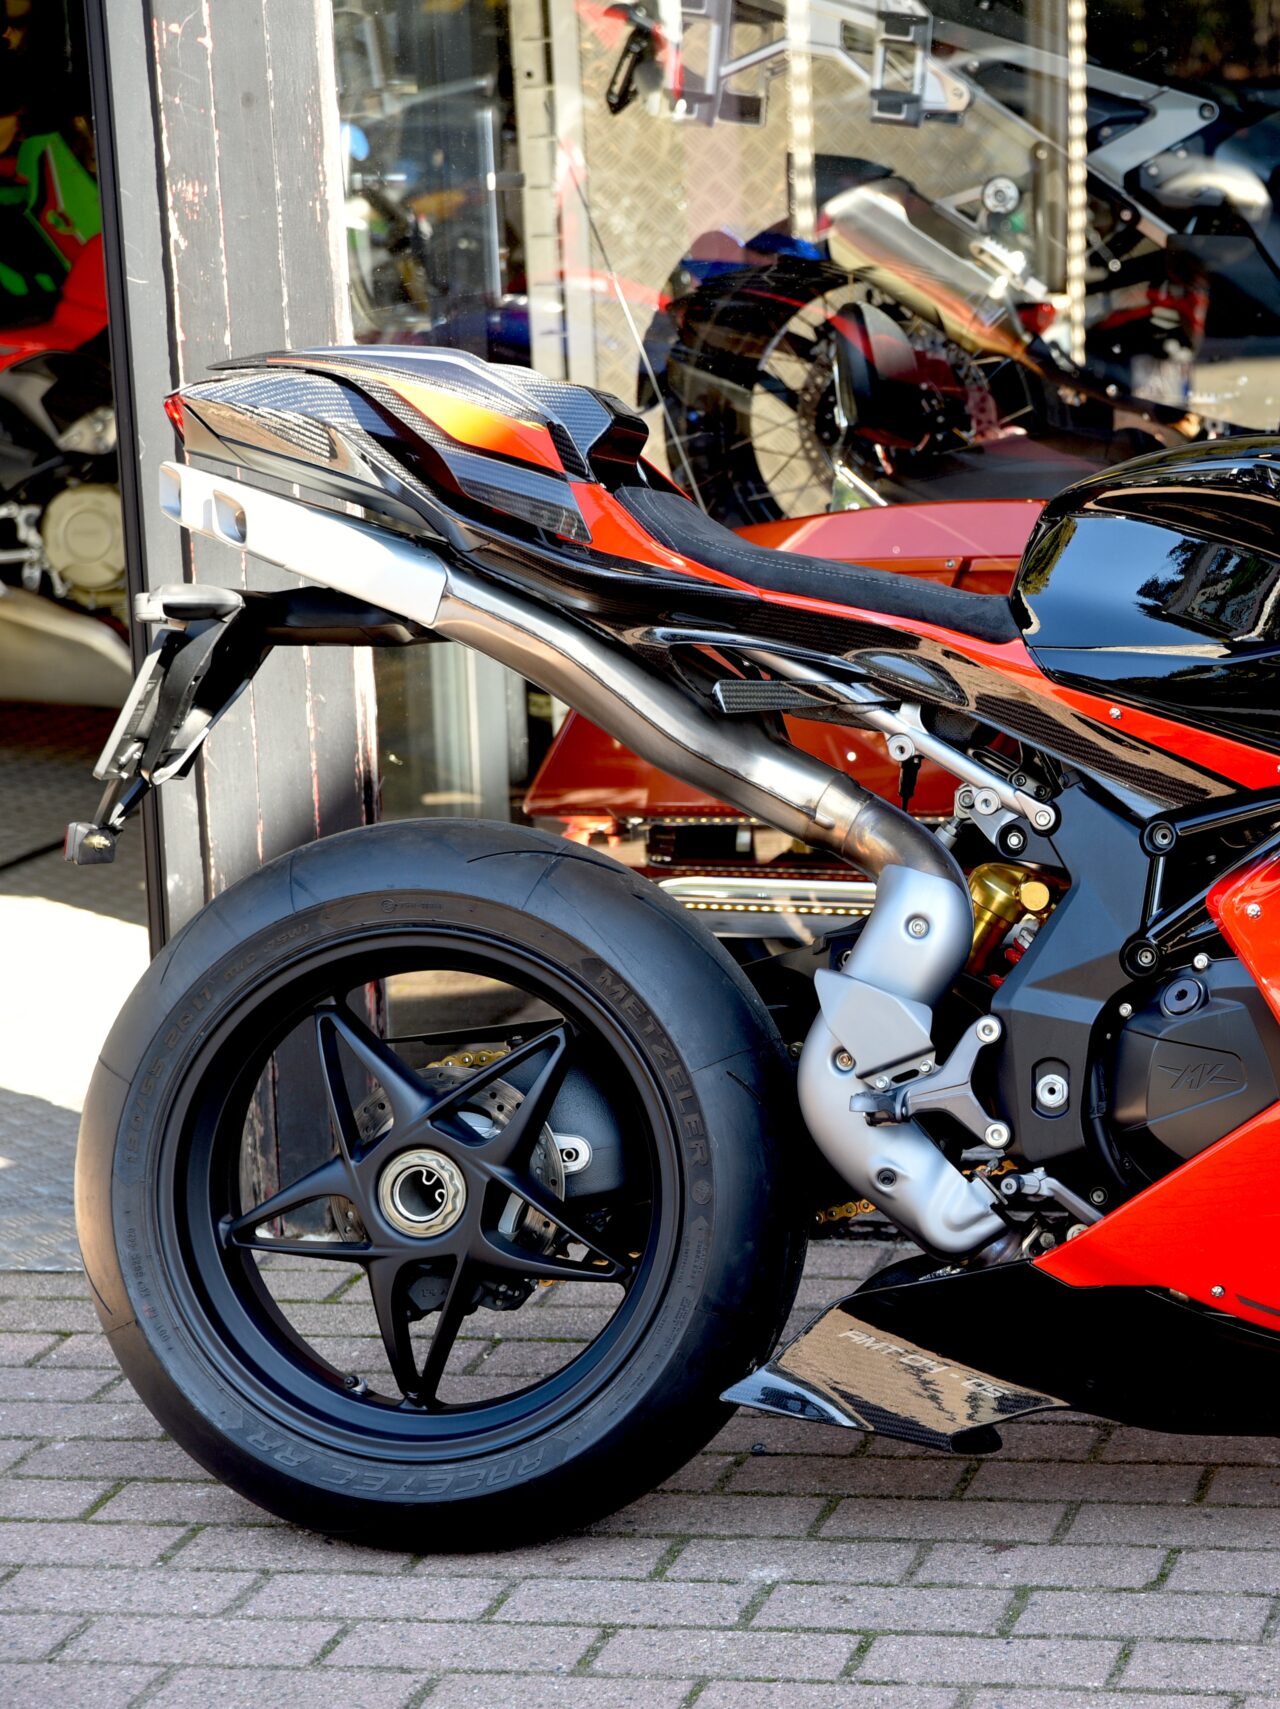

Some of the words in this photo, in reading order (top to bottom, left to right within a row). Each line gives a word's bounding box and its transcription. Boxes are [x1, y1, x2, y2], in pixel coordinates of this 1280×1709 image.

[598, 966, 709, 1168] METZELER
[1168, 1063, 1228, 1090] MV
[246, 1431, 307, 1469] RR
[319, 1446, 548, 1496] RACETEC
